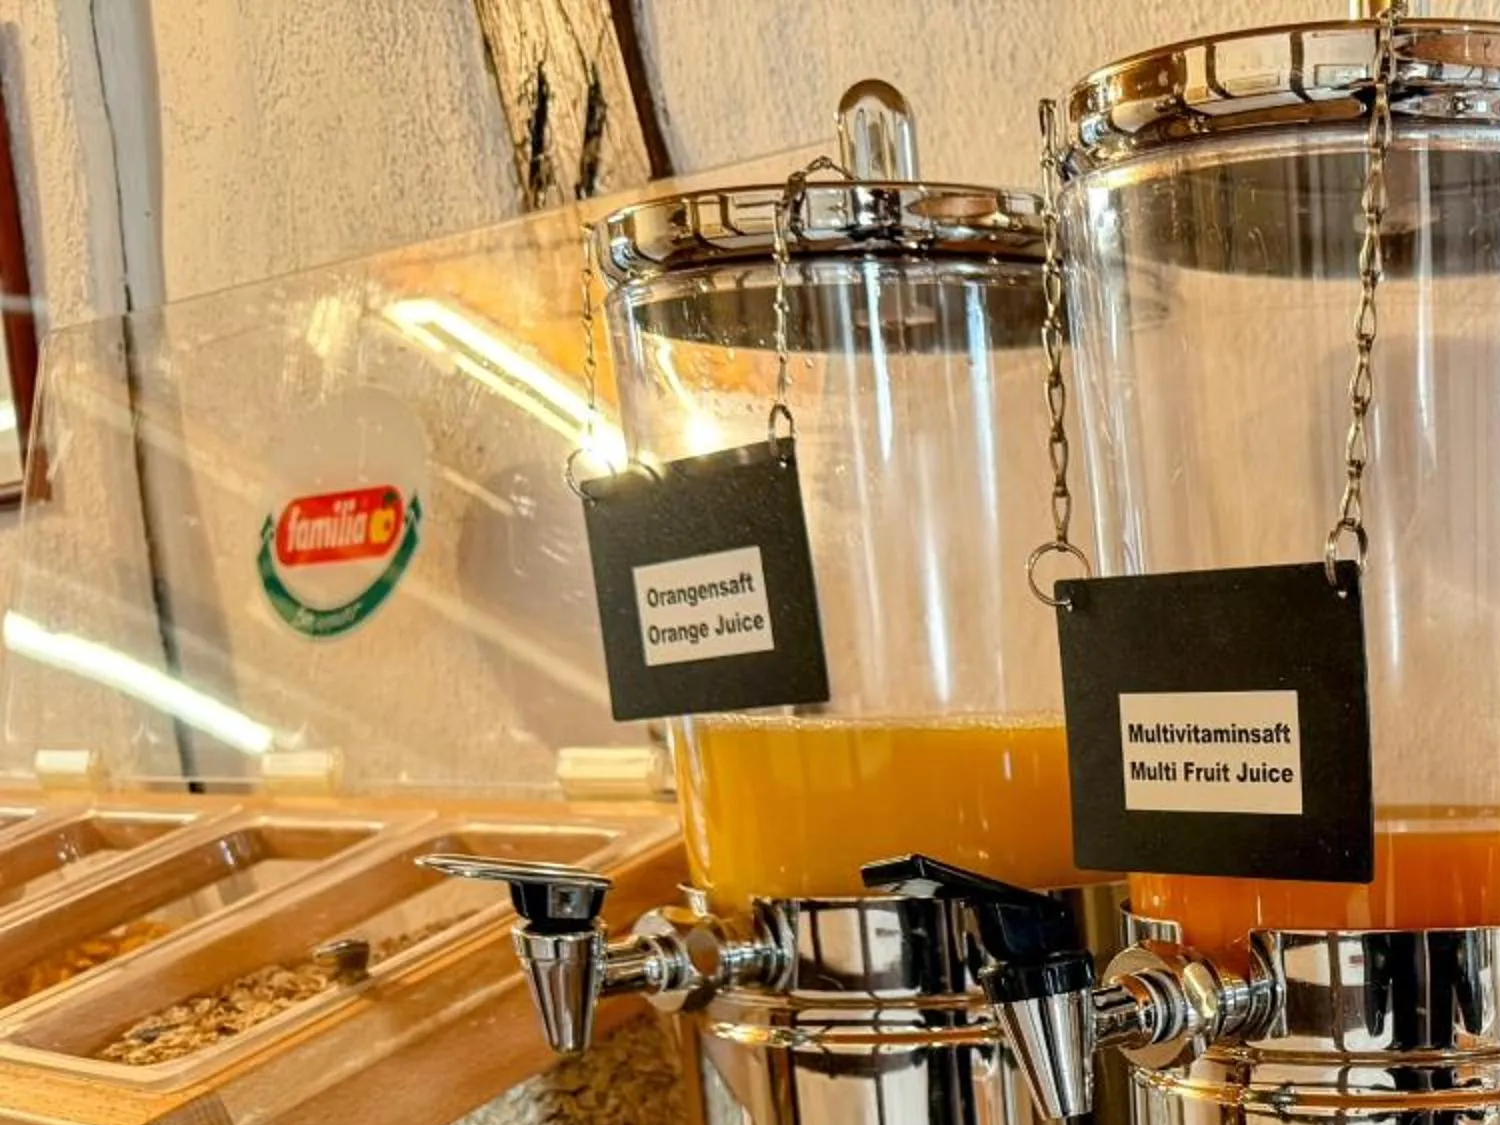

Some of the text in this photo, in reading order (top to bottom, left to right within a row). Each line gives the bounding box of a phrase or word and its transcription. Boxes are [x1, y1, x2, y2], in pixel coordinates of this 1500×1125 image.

[287, 498, 368, 553] familia
[647, 573, 755, 607] Orangensaft
[649, 613, 764, 645] Orange Juice
[1128, 722, 1291, 744] Multivitaminsaft
[1130, 761, 1294, 783] Multi Fruit Juice
